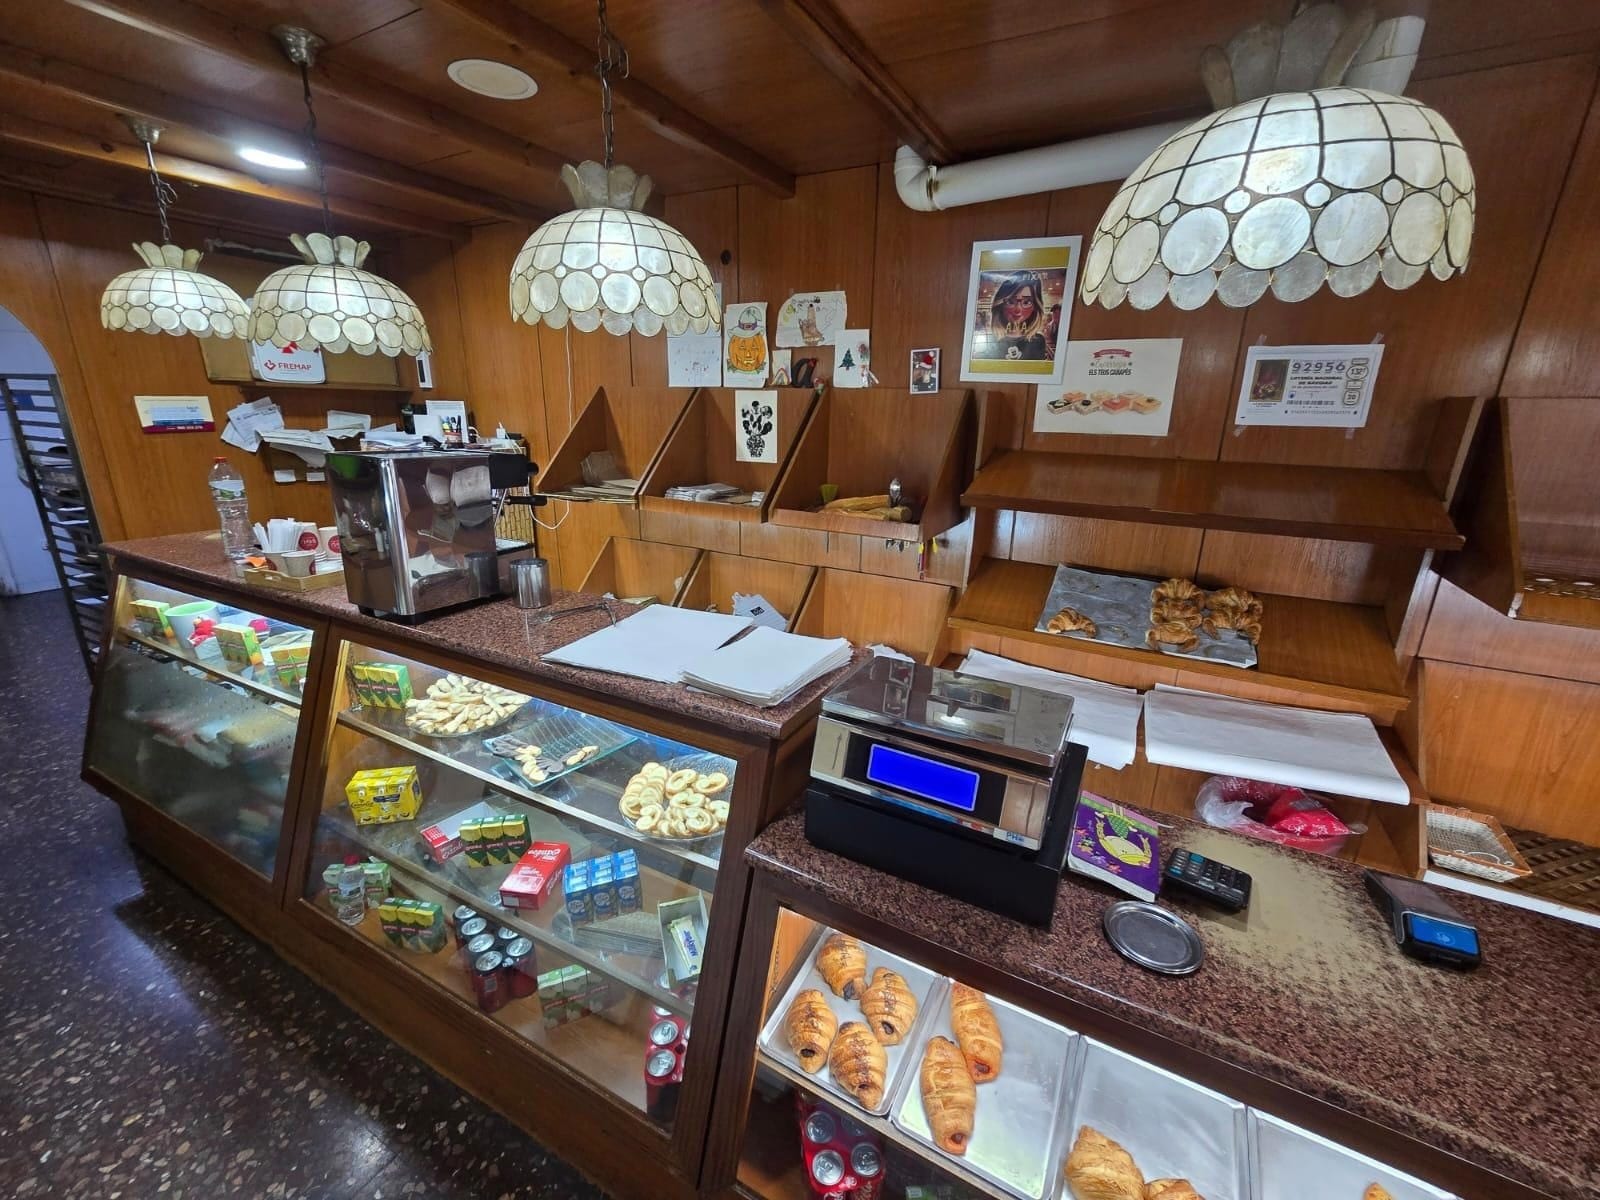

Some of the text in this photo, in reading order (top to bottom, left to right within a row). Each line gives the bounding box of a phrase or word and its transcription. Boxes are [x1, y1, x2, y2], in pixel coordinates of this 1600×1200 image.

[1006, 321, 1028, 333] ANA
[278, 362, 312, 370] FREMAP
[1292, 361, 1346, 372] 92956
[1088, 368, 1098, 376] ELS
